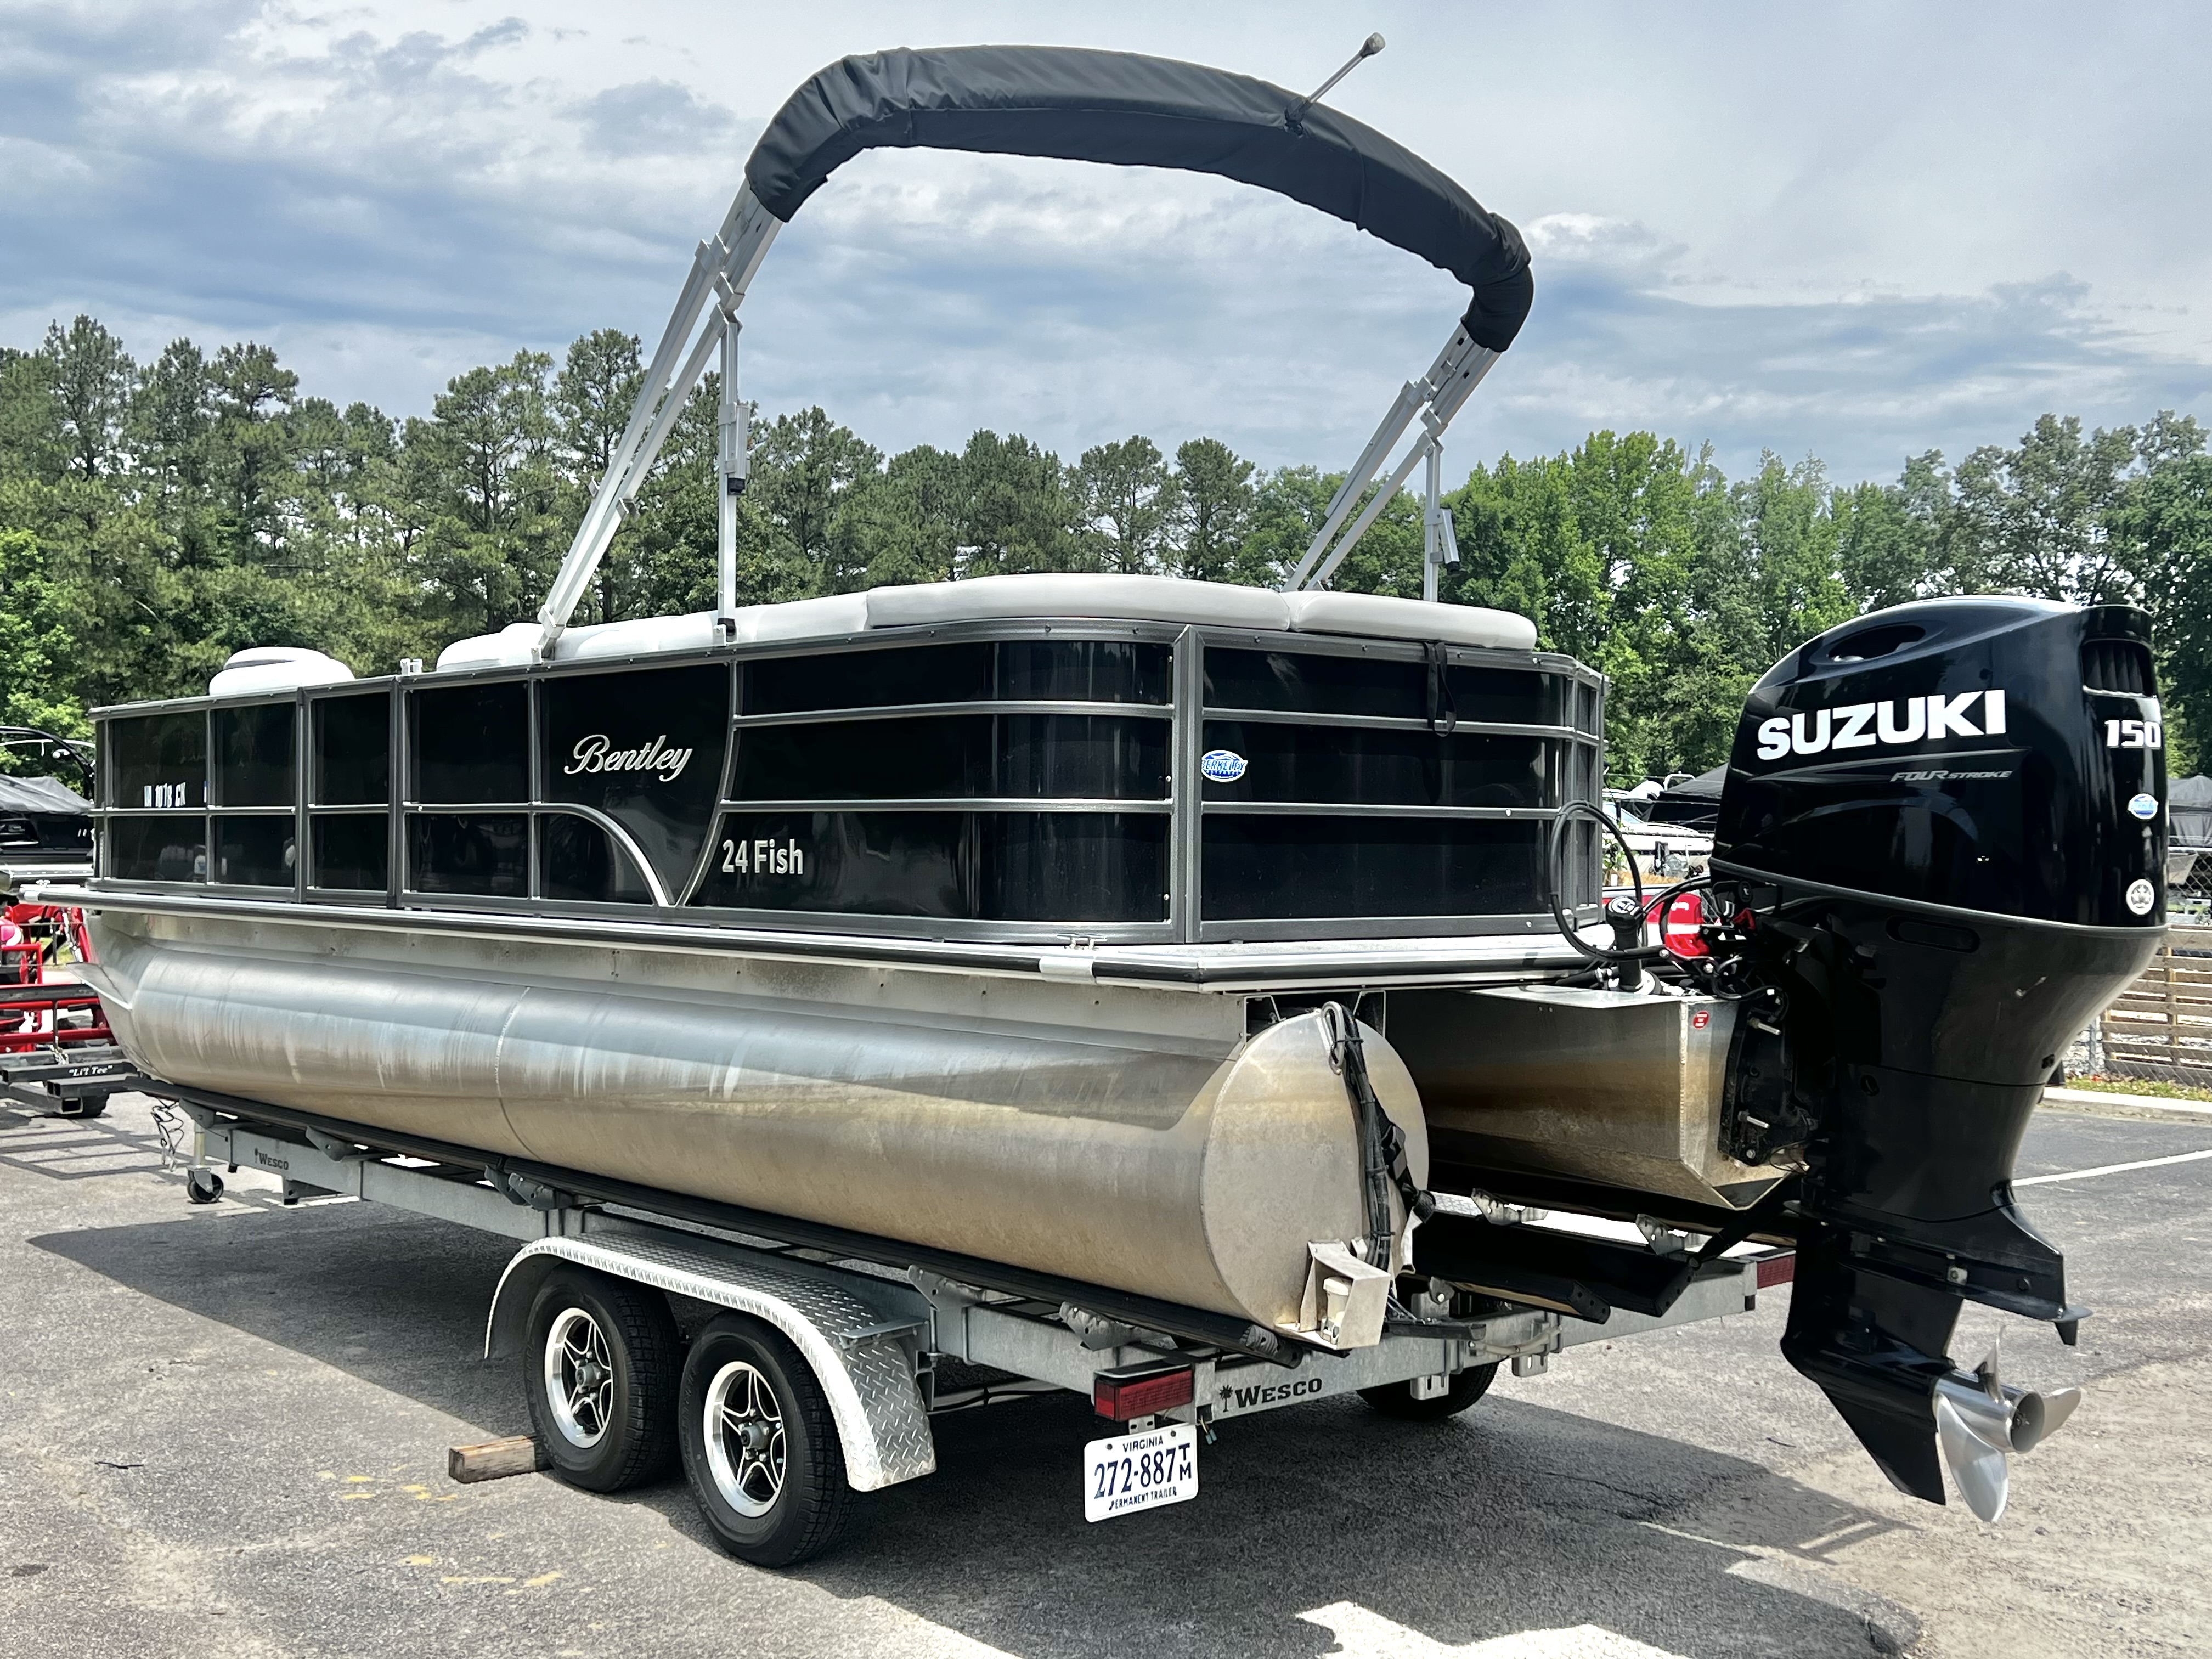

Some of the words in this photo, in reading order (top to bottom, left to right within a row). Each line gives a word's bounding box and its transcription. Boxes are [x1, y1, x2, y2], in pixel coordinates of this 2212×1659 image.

[1757, 689, 2006, 760] SUZUKI
[2104, 719, 2162, 749] 150
[563, 734, 693, 782] Bentley
[1890, 770, 1949, 782] FOUR
[1947, 771, 2013, 779] STROKE
[721, 839, 748, 873] 24
[754, 838, 803, 874] Fish
[258, 1152, 289, 1170] WESCO
[1234, 1378, 1323, 1408] WESCO
[1122, 1435, 1164, 1453] VIRGINIA
[1178, 1442, 1190, 1461] T
[1093, 1447, 1176, 1499] 272-887
[1179, 1462, 1192, 1481] M
[1109, 1492, 1149, 1510] PERMANENT
[1150, 1486, 1177, 1502] TRAILER
